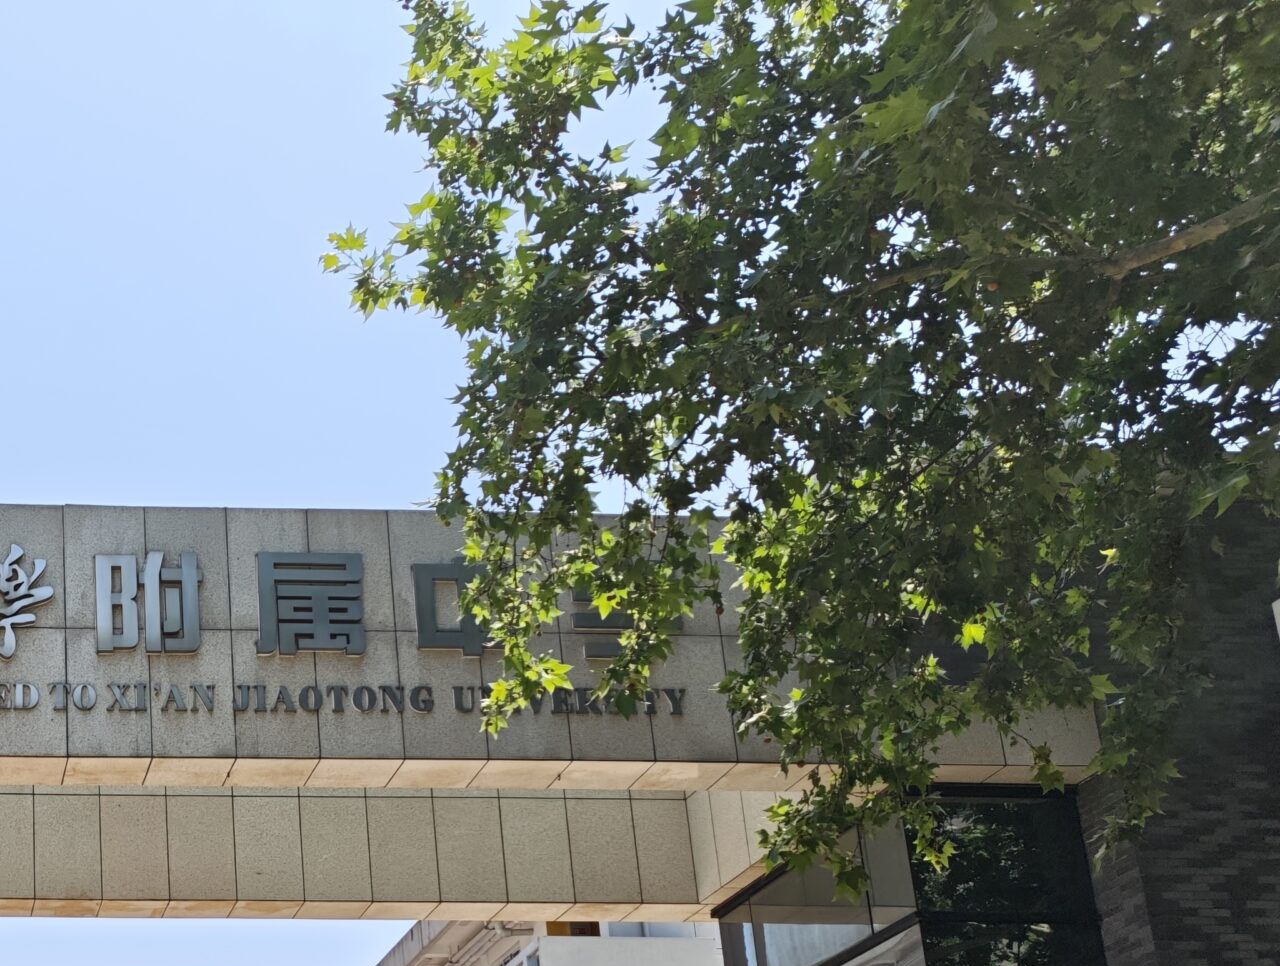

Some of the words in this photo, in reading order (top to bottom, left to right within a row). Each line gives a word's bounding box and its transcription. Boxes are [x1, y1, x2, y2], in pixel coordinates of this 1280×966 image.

[47, 682, 97, 711] TO
[106, 683, 216, 714] XI'AN
[232, 684, 434, 715] JIAOTONG
[452, 685, 687, 716] UVERTY
